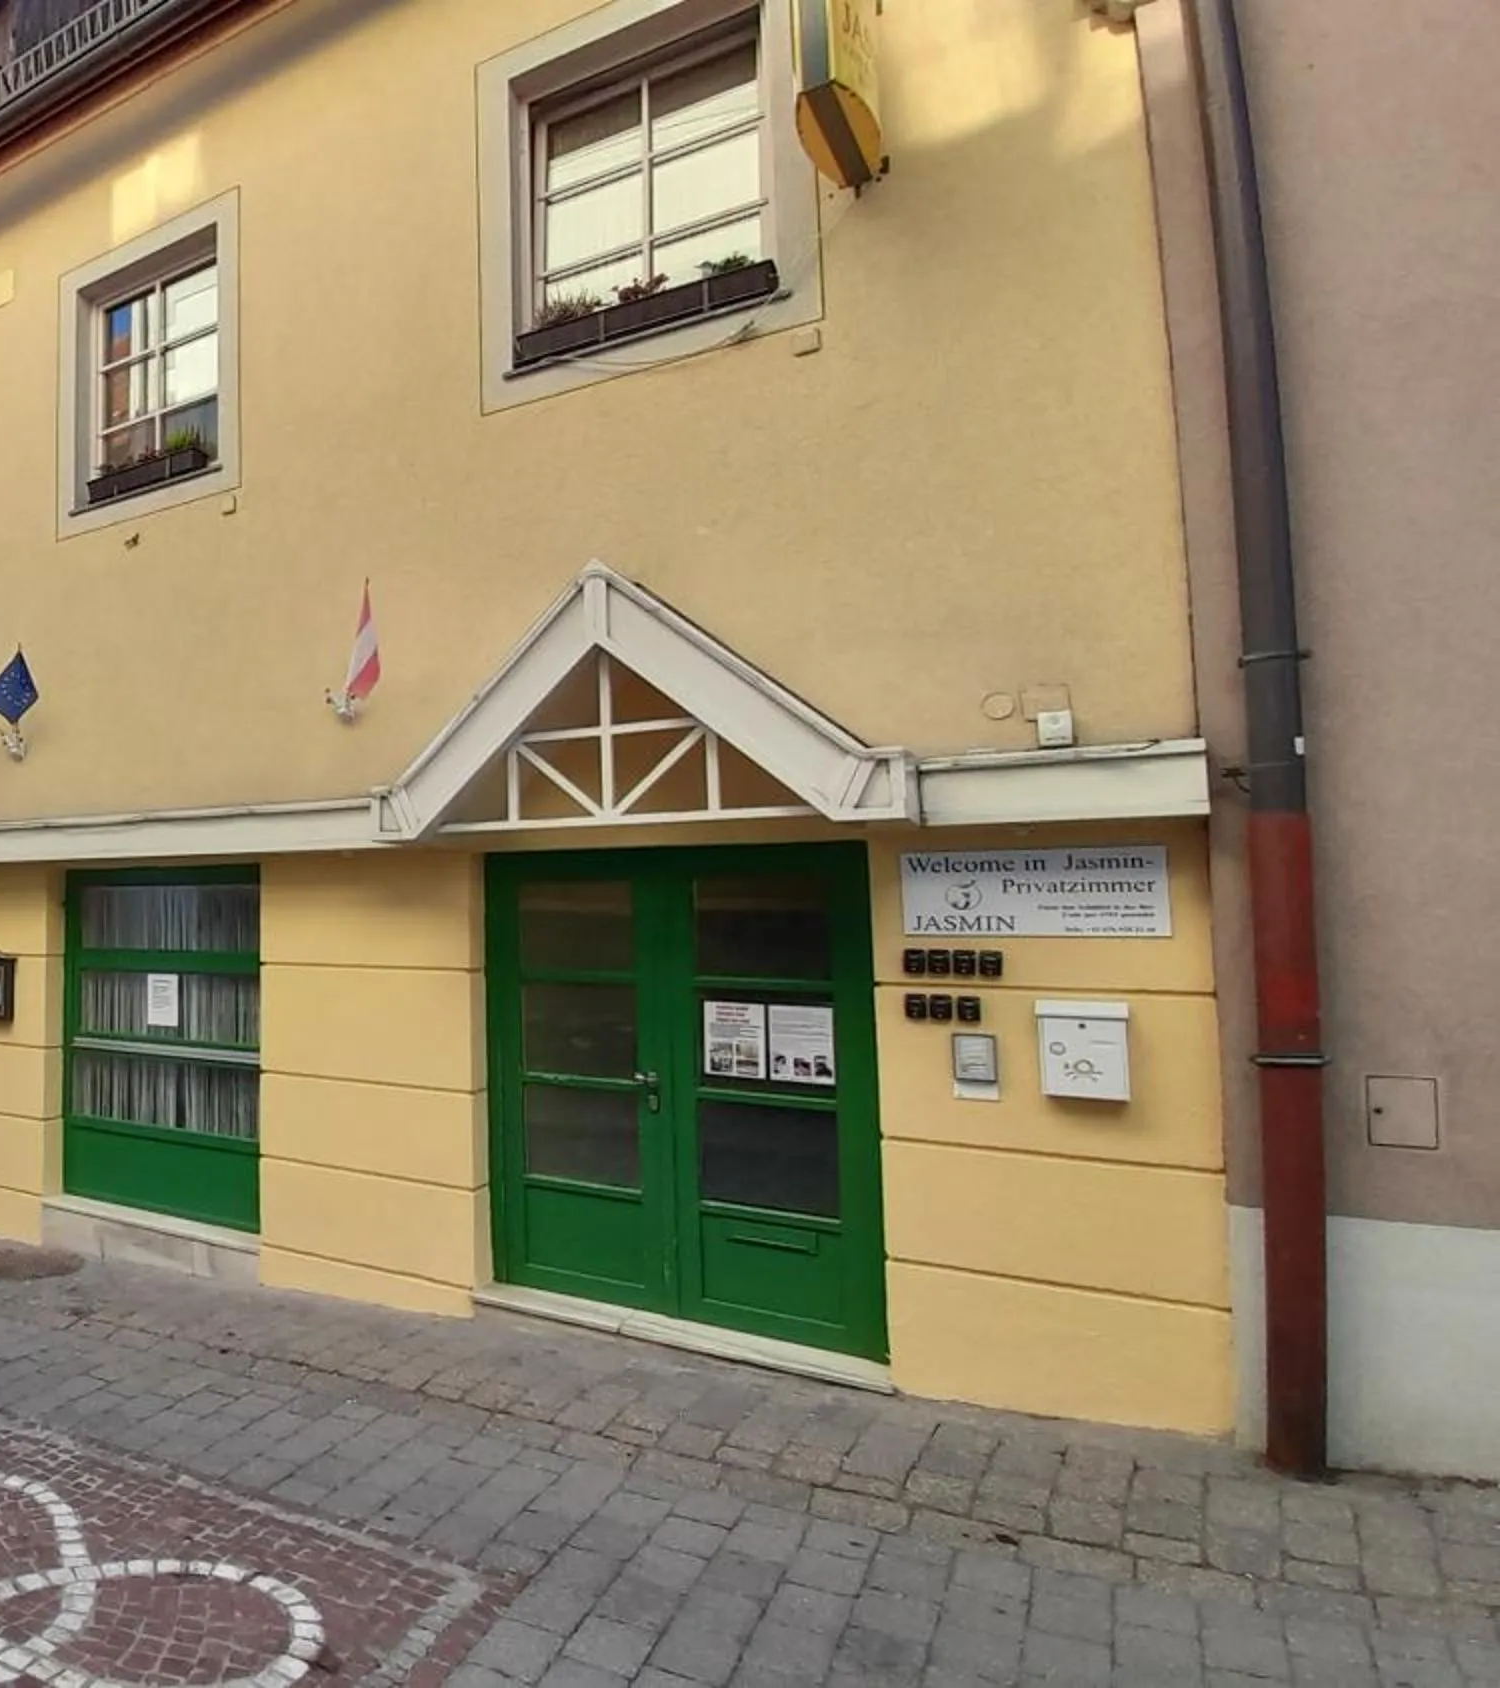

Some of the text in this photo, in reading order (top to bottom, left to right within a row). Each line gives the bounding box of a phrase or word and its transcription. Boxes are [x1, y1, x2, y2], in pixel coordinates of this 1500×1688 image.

[907, 856, 1015, 874] Welcome
[1024, 856, 1046, 872] in
[1002, 878, 1156, 895] Privatzimmer
[913, 915, 1016, 932] JASMIN
